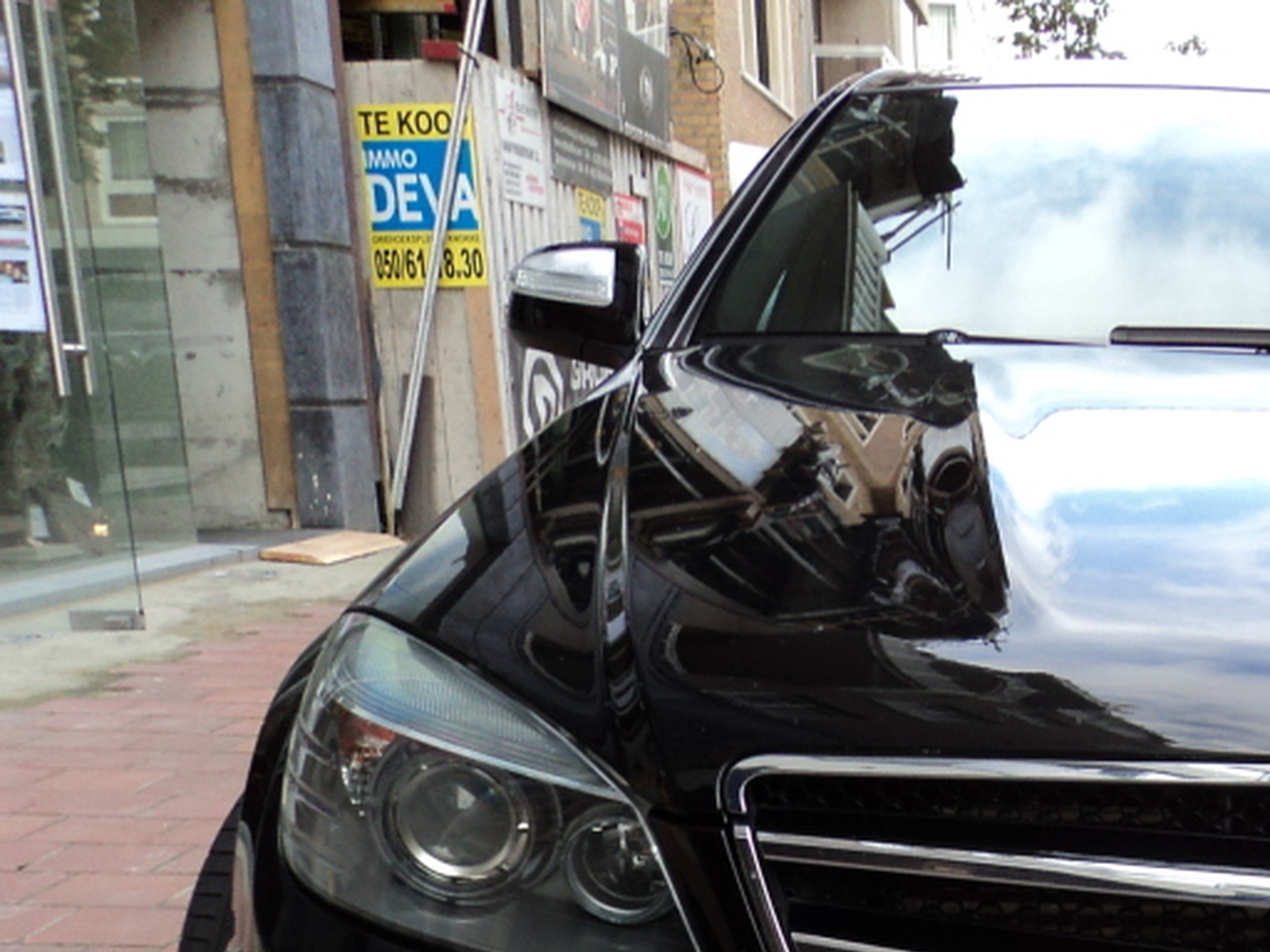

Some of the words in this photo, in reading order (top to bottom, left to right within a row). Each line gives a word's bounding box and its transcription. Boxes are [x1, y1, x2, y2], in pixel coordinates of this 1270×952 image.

[358, 111, 390, 135] TE
[397, 110, 468, 135] KOO
[362, 148, 417, 169] IMMO
[366, 173, 478, 222] DEVA
